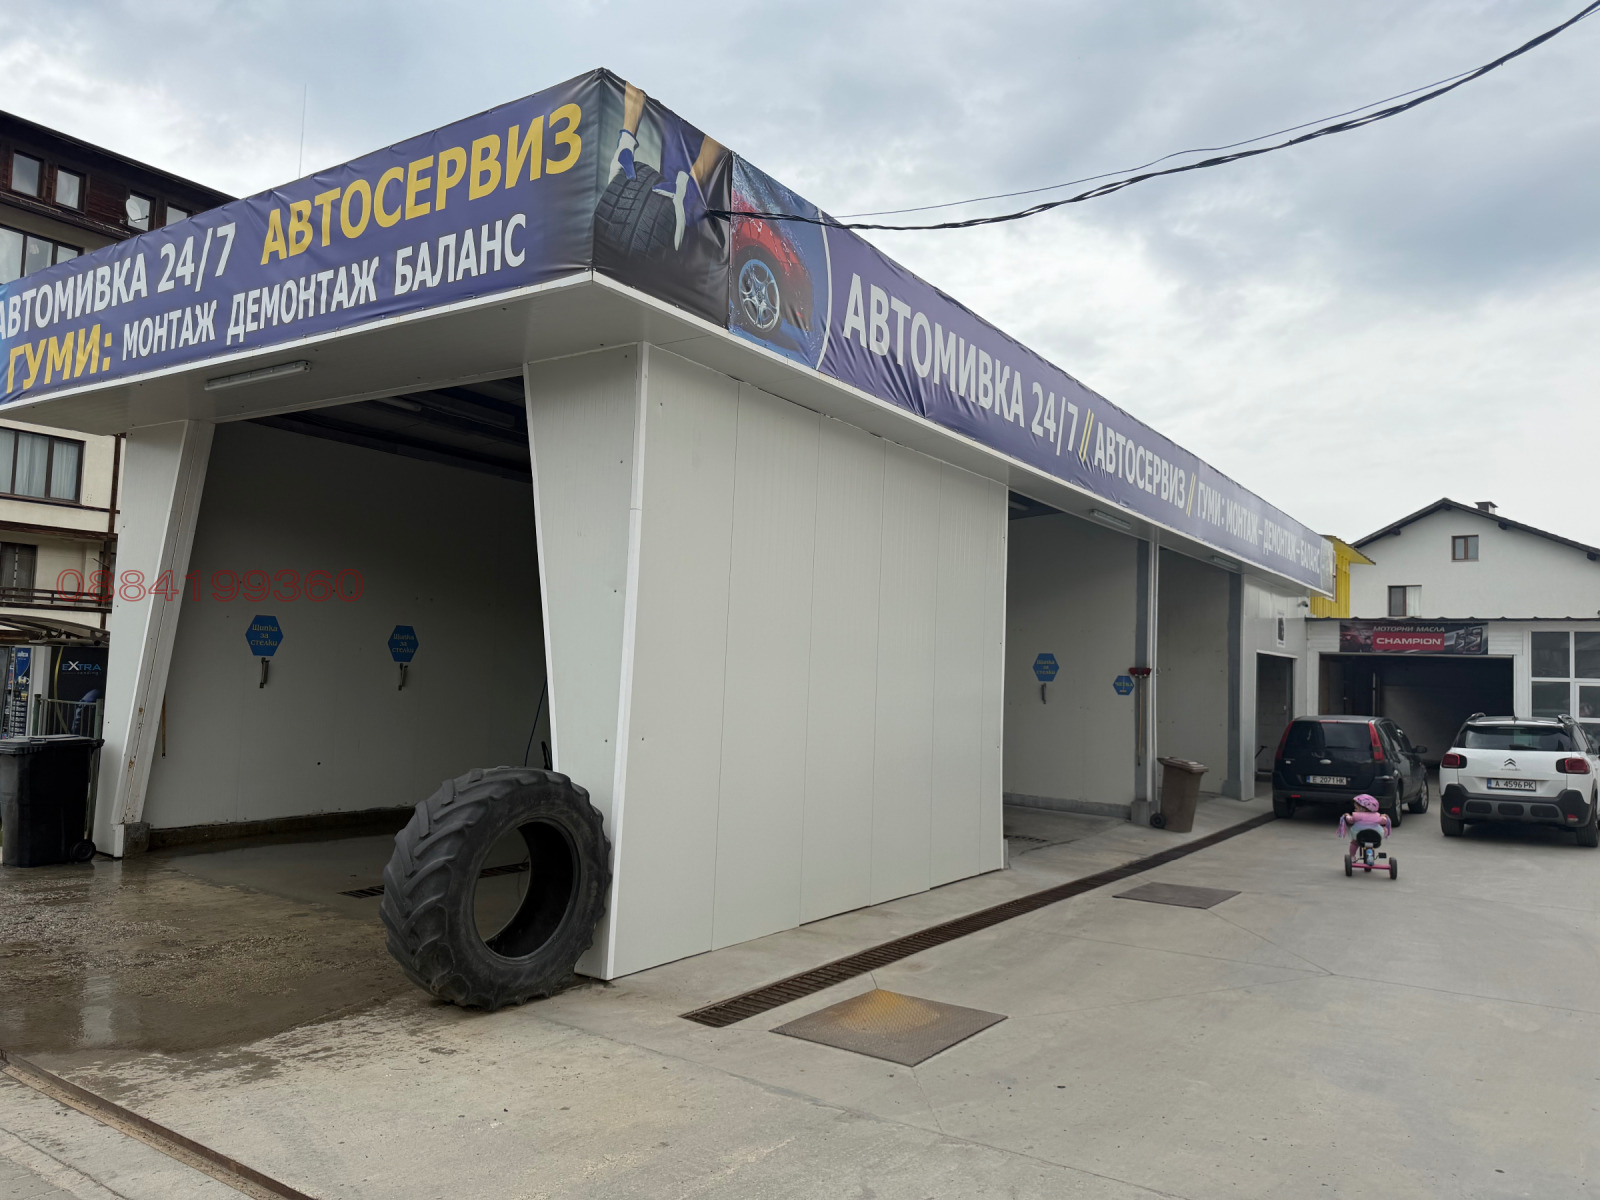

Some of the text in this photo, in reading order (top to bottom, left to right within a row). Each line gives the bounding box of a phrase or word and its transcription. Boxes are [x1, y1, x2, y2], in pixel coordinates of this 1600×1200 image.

[157, 222, 236, 293] 24/7
[260, 103, 582, 265] АВТОСЕРВИЗ
[6, 213, 527, 394] ГУМИ: МОНТАЖ ДЕМОНТАЖ БАЛАНС
[843, 272, 1025, 428] АВТОМИВКА
[1031, 382, 1079, 456] 24/7
[1094, 422, 1186, 509] АВТОСЕРВИЗ
[62, 661, 102, 671] EXTRA
[1376, 637, 1441, 645] CHAMPION
